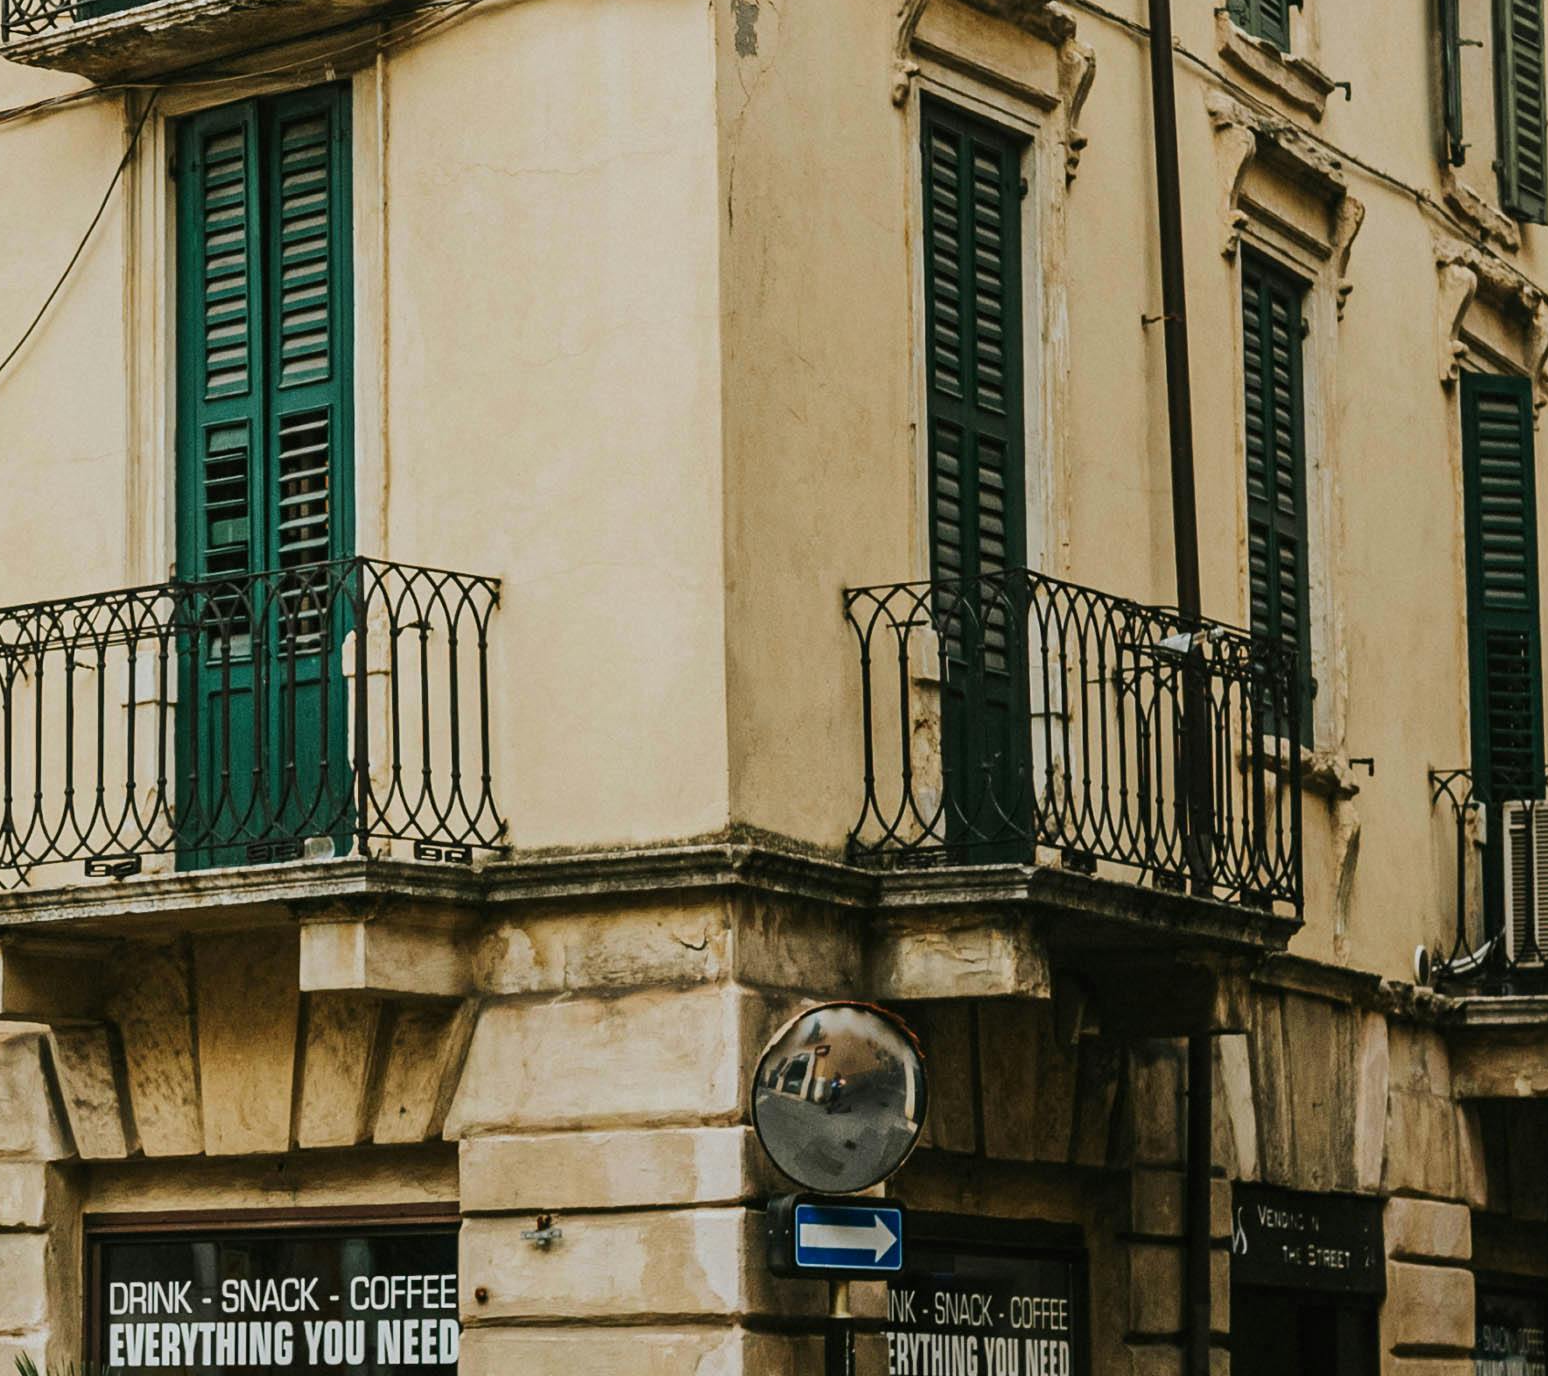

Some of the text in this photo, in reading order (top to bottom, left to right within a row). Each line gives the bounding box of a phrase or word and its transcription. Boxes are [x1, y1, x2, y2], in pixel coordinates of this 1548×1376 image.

[1307, 1244, 1350, 1269] STREET
[110, 1280, 192, 1315] DRINK
[221, 1277, 319, 1312] SNACK
[350, 1274, 457, 1311] COFFEE
[887, 1289, 916, 1323] INK
[934, 1291, 993, 1326] SNACK
[1010, 1296, 1068, 1330] COFFEE
[109, 1319, 459, 1367] EVERYTHING YOU NEED
